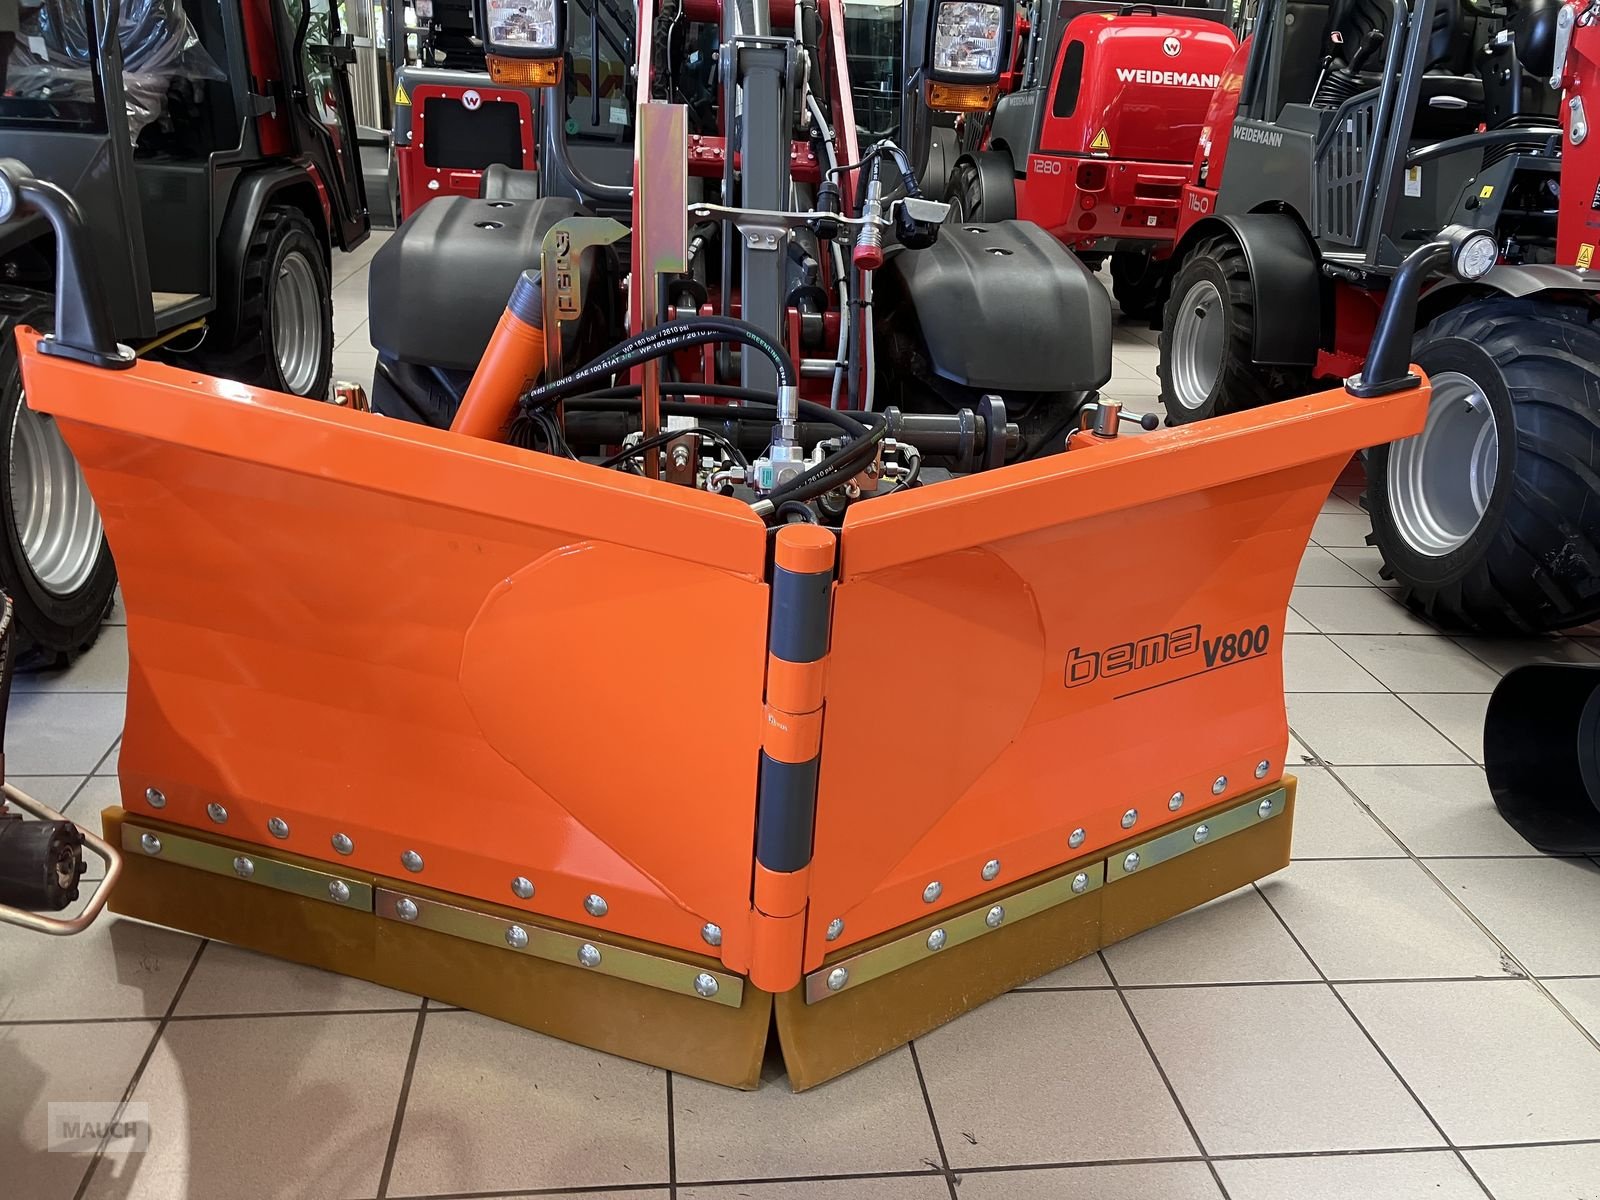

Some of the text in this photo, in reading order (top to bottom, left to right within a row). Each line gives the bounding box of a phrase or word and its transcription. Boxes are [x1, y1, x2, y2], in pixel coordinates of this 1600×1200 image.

[1232, 125, 1283, 147] WEIDEMANN
[1033, 159, 1061, 175] 1280
[1188, 192, 1209, 214] 1160
[622, 343, 633, 354] WP
[646, 334, 657, 343] bar
[679, 324, 690, 332] psi
[556, 376, 573, 387] DN10
[575, 369, 589, 380] SAE
[590, 363, 602, 374] 100
[602, 356, 620, 369] R1AT
[638, 345, 652, 354] WP
[653, 340, 666, 349] 180
[666, 336, 679, 345] bar
[745, 331, 781, 363] GREENLINE
[779, 366, 786, 379] EN
[824, 465, 834, 476] psi
[1064, 624, 1270, 689] bema V800
